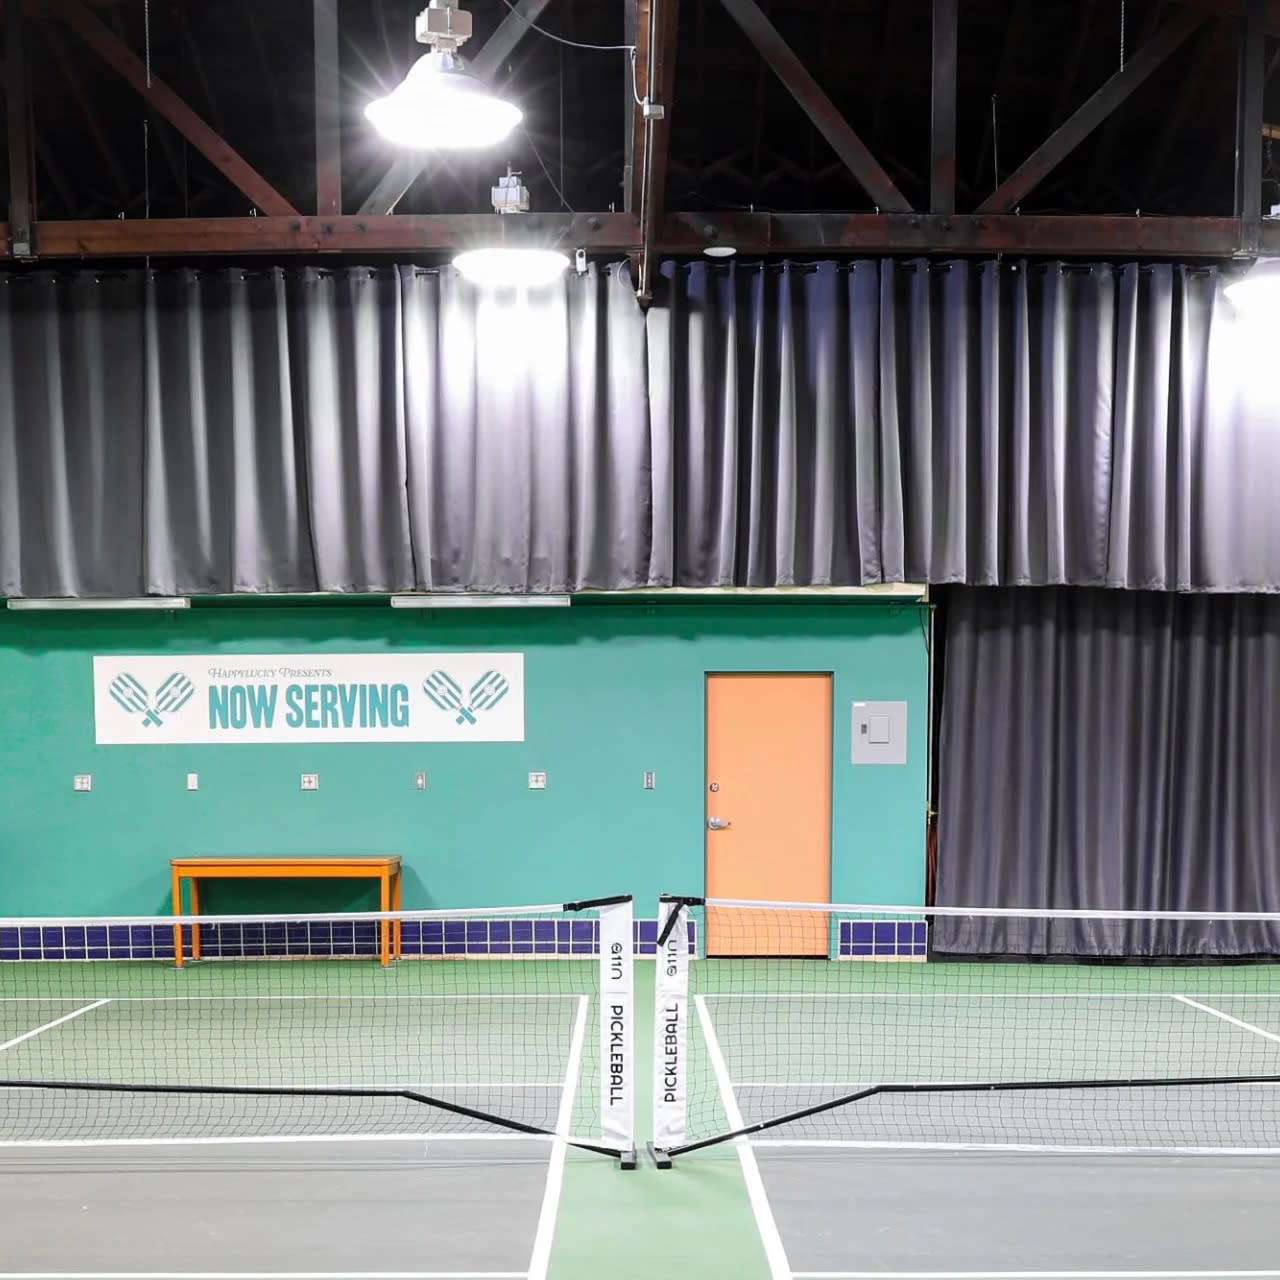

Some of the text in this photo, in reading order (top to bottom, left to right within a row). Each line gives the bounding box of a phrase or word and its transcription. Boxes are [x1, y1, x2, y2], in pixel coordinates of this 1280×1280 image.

[209, 683, 409, 729] NOW SERVING
[610, 1005, 624, 1106] PICKLEBALL
[664, 1003, 678, 1102] PICKLEBALL
